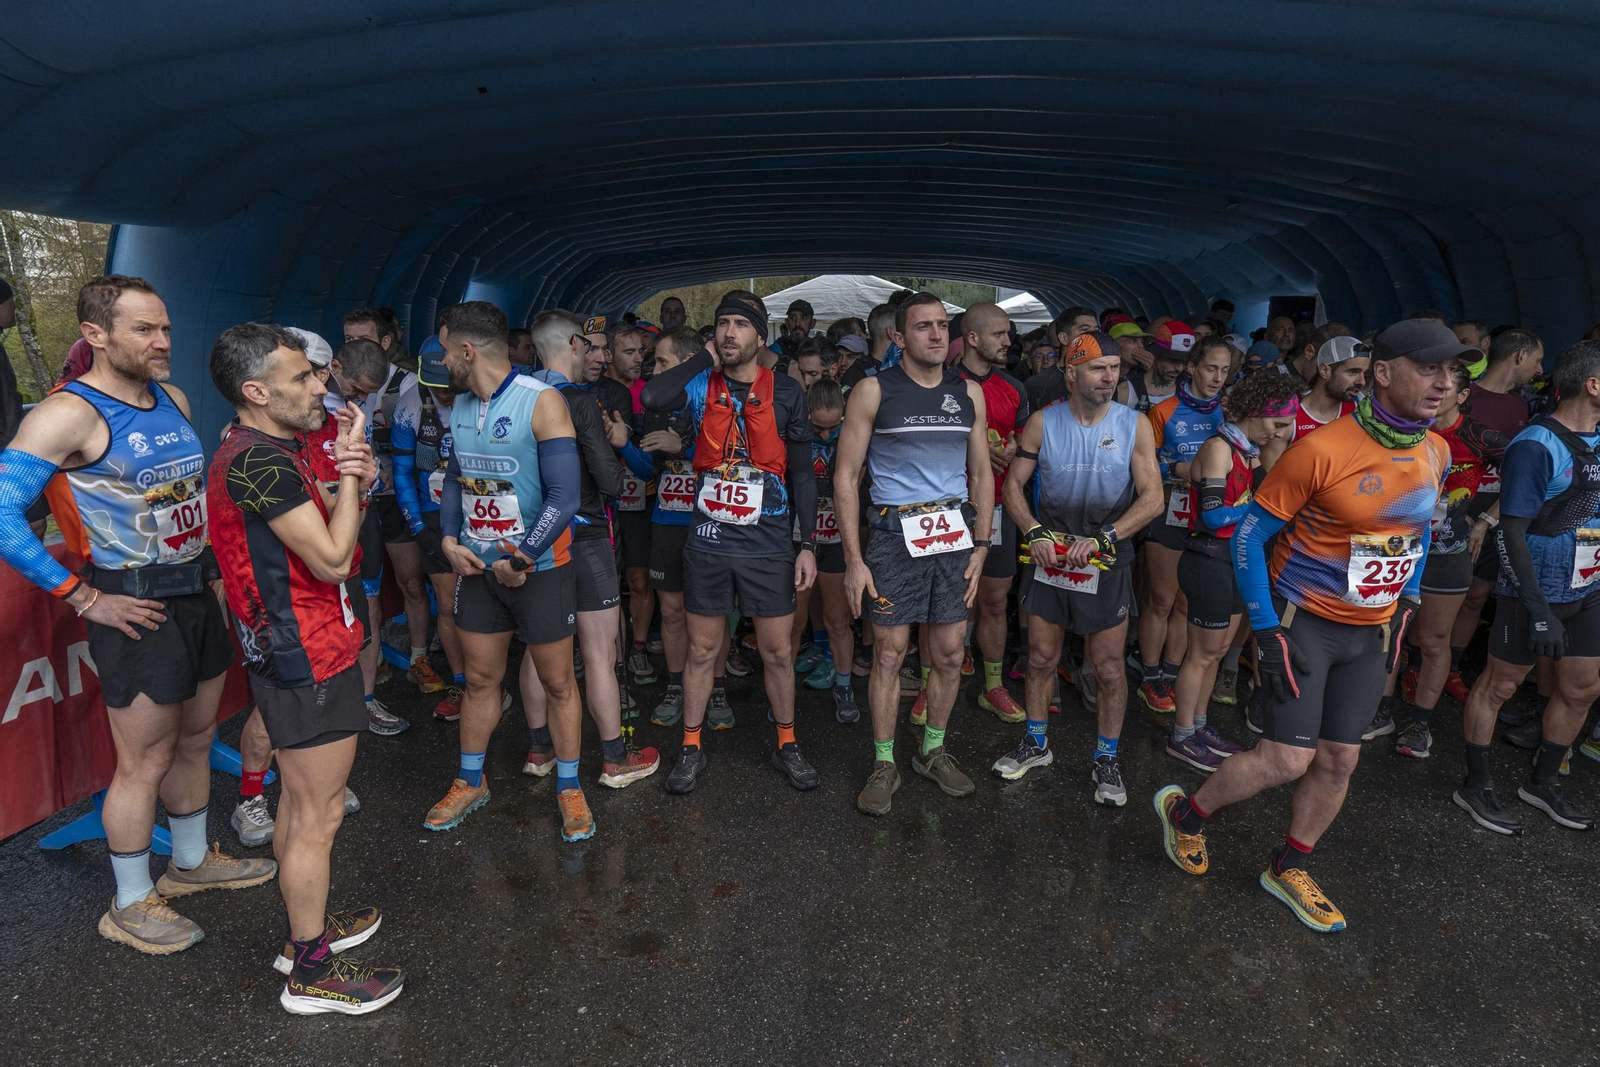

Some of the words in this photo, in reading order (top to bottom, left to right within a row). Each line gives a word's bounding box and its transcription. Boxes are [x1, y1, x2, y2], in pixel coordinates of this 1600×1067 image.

[903, 415, 962, 424] XESTEIRAS
[460, 458, 512, 471] PLASTIFER
[1060, 463, 1113, 473] XESTERAS
[663, 476, 695, 494] 228
[714, 482, 748, 505] 115
[171, 500, 203, 532] 101
[474, 498, 501, 520] 66
[526, 505, 557, 546] BIOSBARDO
[920, 513, 951, 537] 94
[1236, 513, 1260, 570] RUNMANIAK
[1362, 558, 1412, 584] 239
[290, 980, 303, 992] LA
[305, 986, 362, 1007] SPORTIVA
